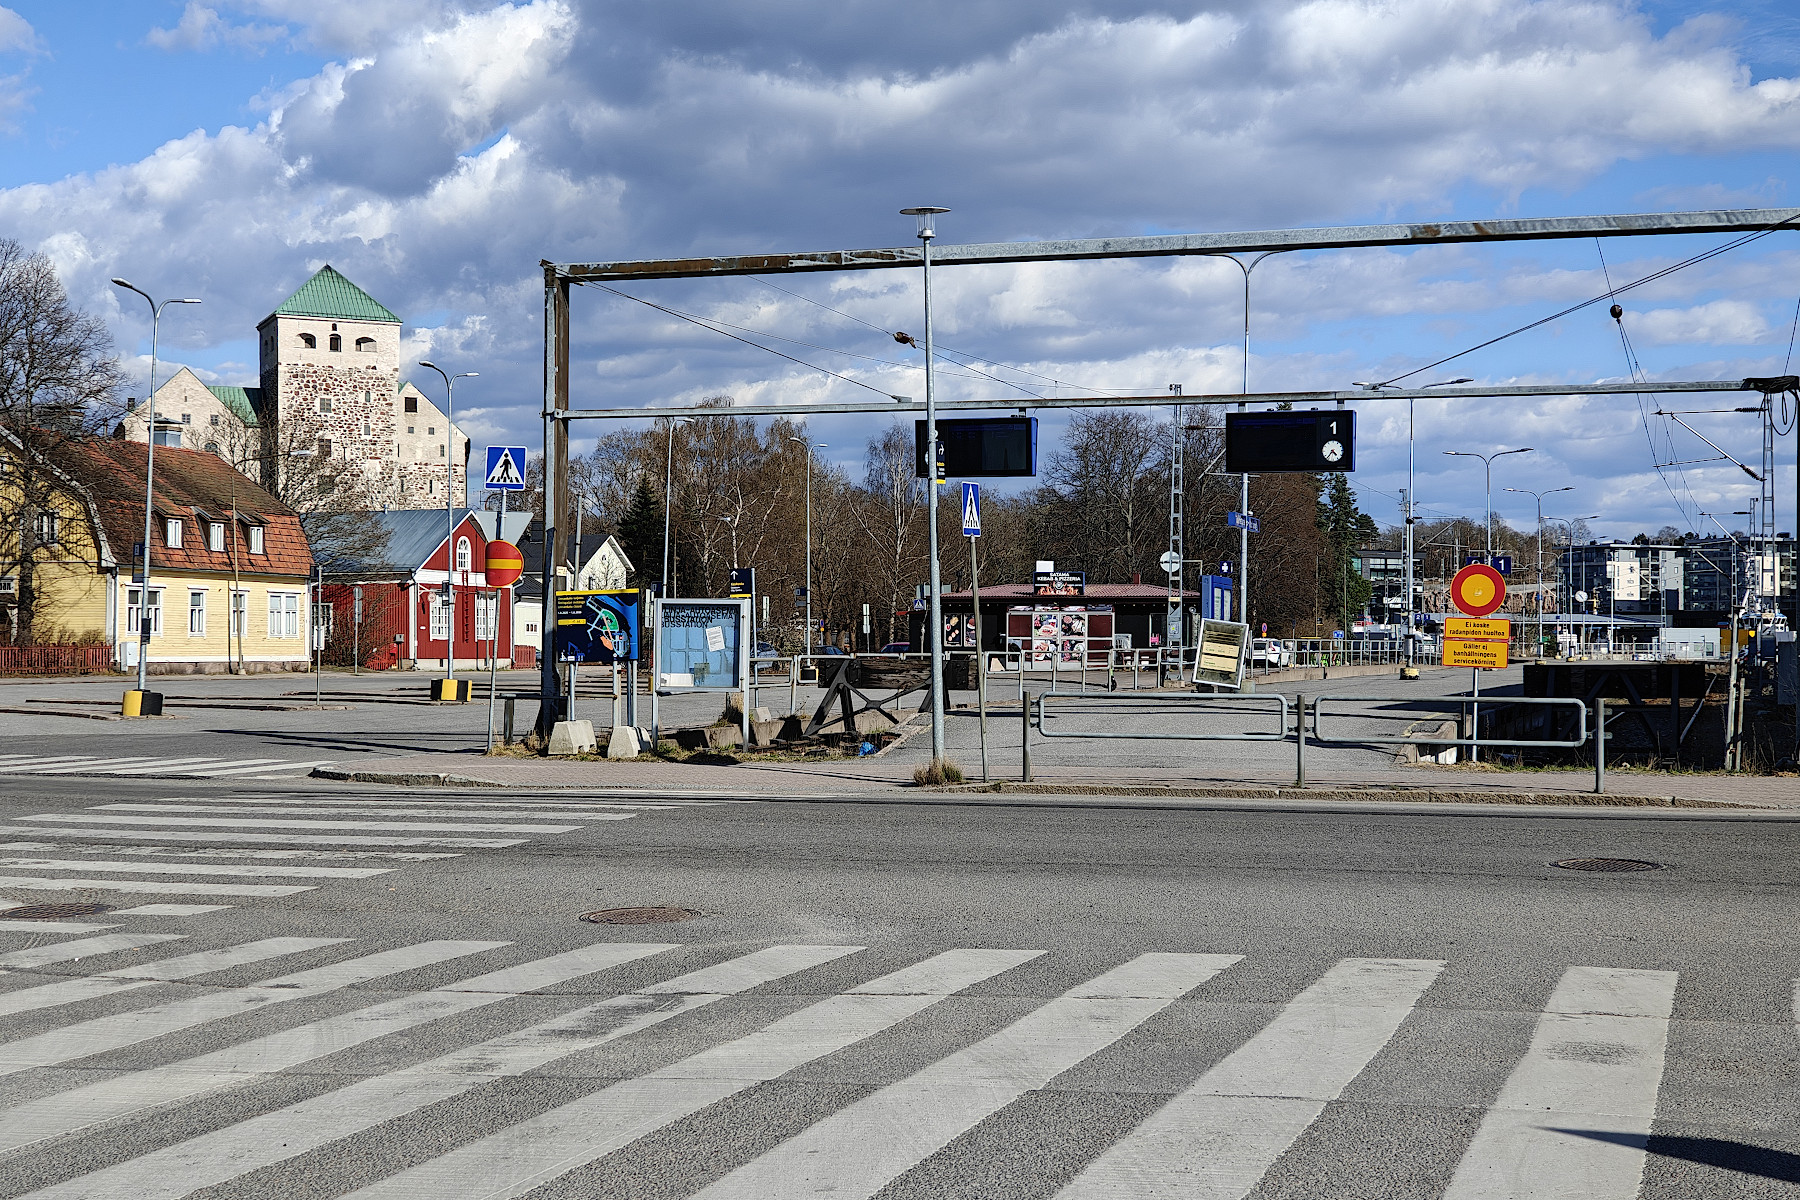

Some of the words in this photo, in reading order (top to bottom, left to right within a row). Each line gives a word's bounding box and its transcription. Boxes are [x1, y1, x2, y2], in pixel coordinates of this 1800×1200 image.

[1329, 421, 1337, 435] 1
[1498, 559, 1504, 570] 1
[1453, 658, 1497, 666] servicekörning
